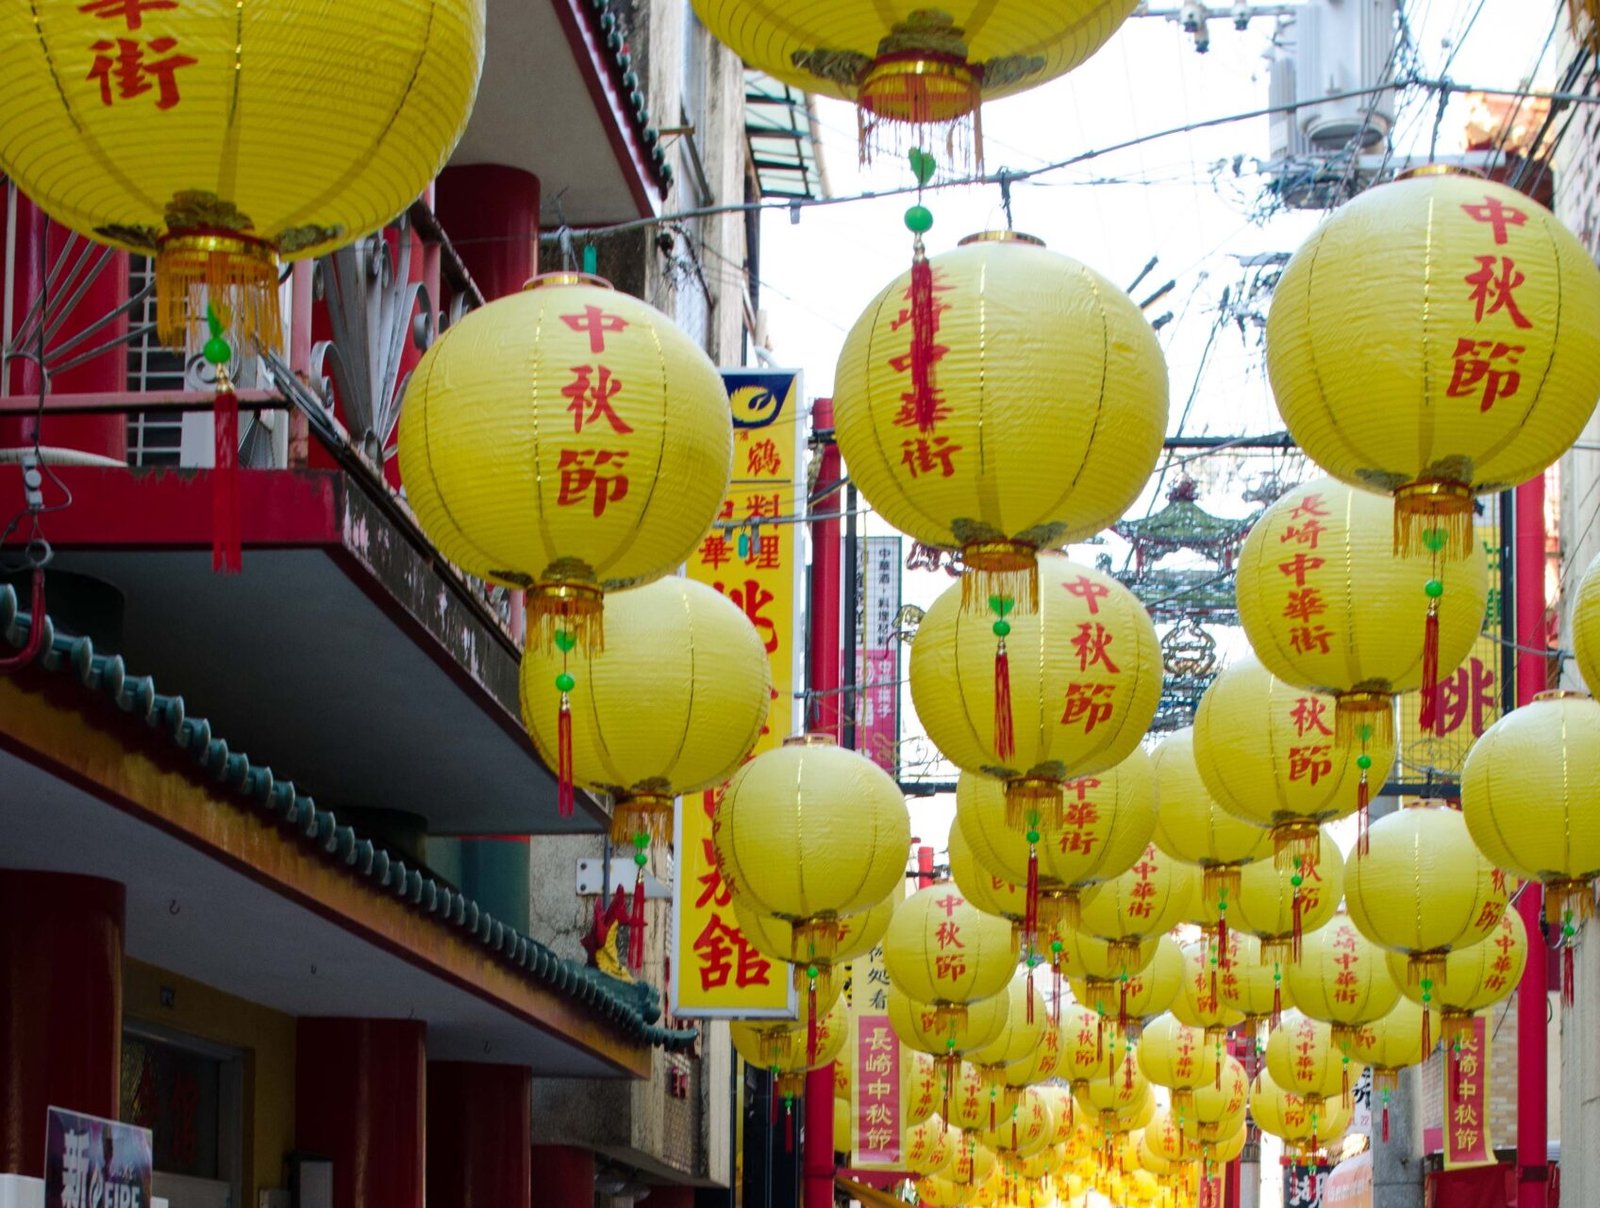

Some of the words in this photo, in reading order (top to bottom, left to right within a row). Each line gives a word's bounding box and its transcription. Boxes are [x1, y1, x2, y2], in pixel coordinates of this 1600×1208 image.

[1445, 195, 1534, 414] 中秋節
[556, 304, 635, 518] 中秋節
[744, 494, 781, 570] 料理
[1279, 493, 1335, 656] 長崎中華街
[1060, 574, 1122, 735] 中秋節
[1288, 697, 1334, 787] 秋節
[1058, 777, 1101, 856] 中華街
[1291, 838, 1322, 915] 秋節
[935, 894, 966, 982] 中秋節
[1075, 1012, 1096, 1068] 中秋節
[866, 1027, 894, 1152] 長崎中秋節
